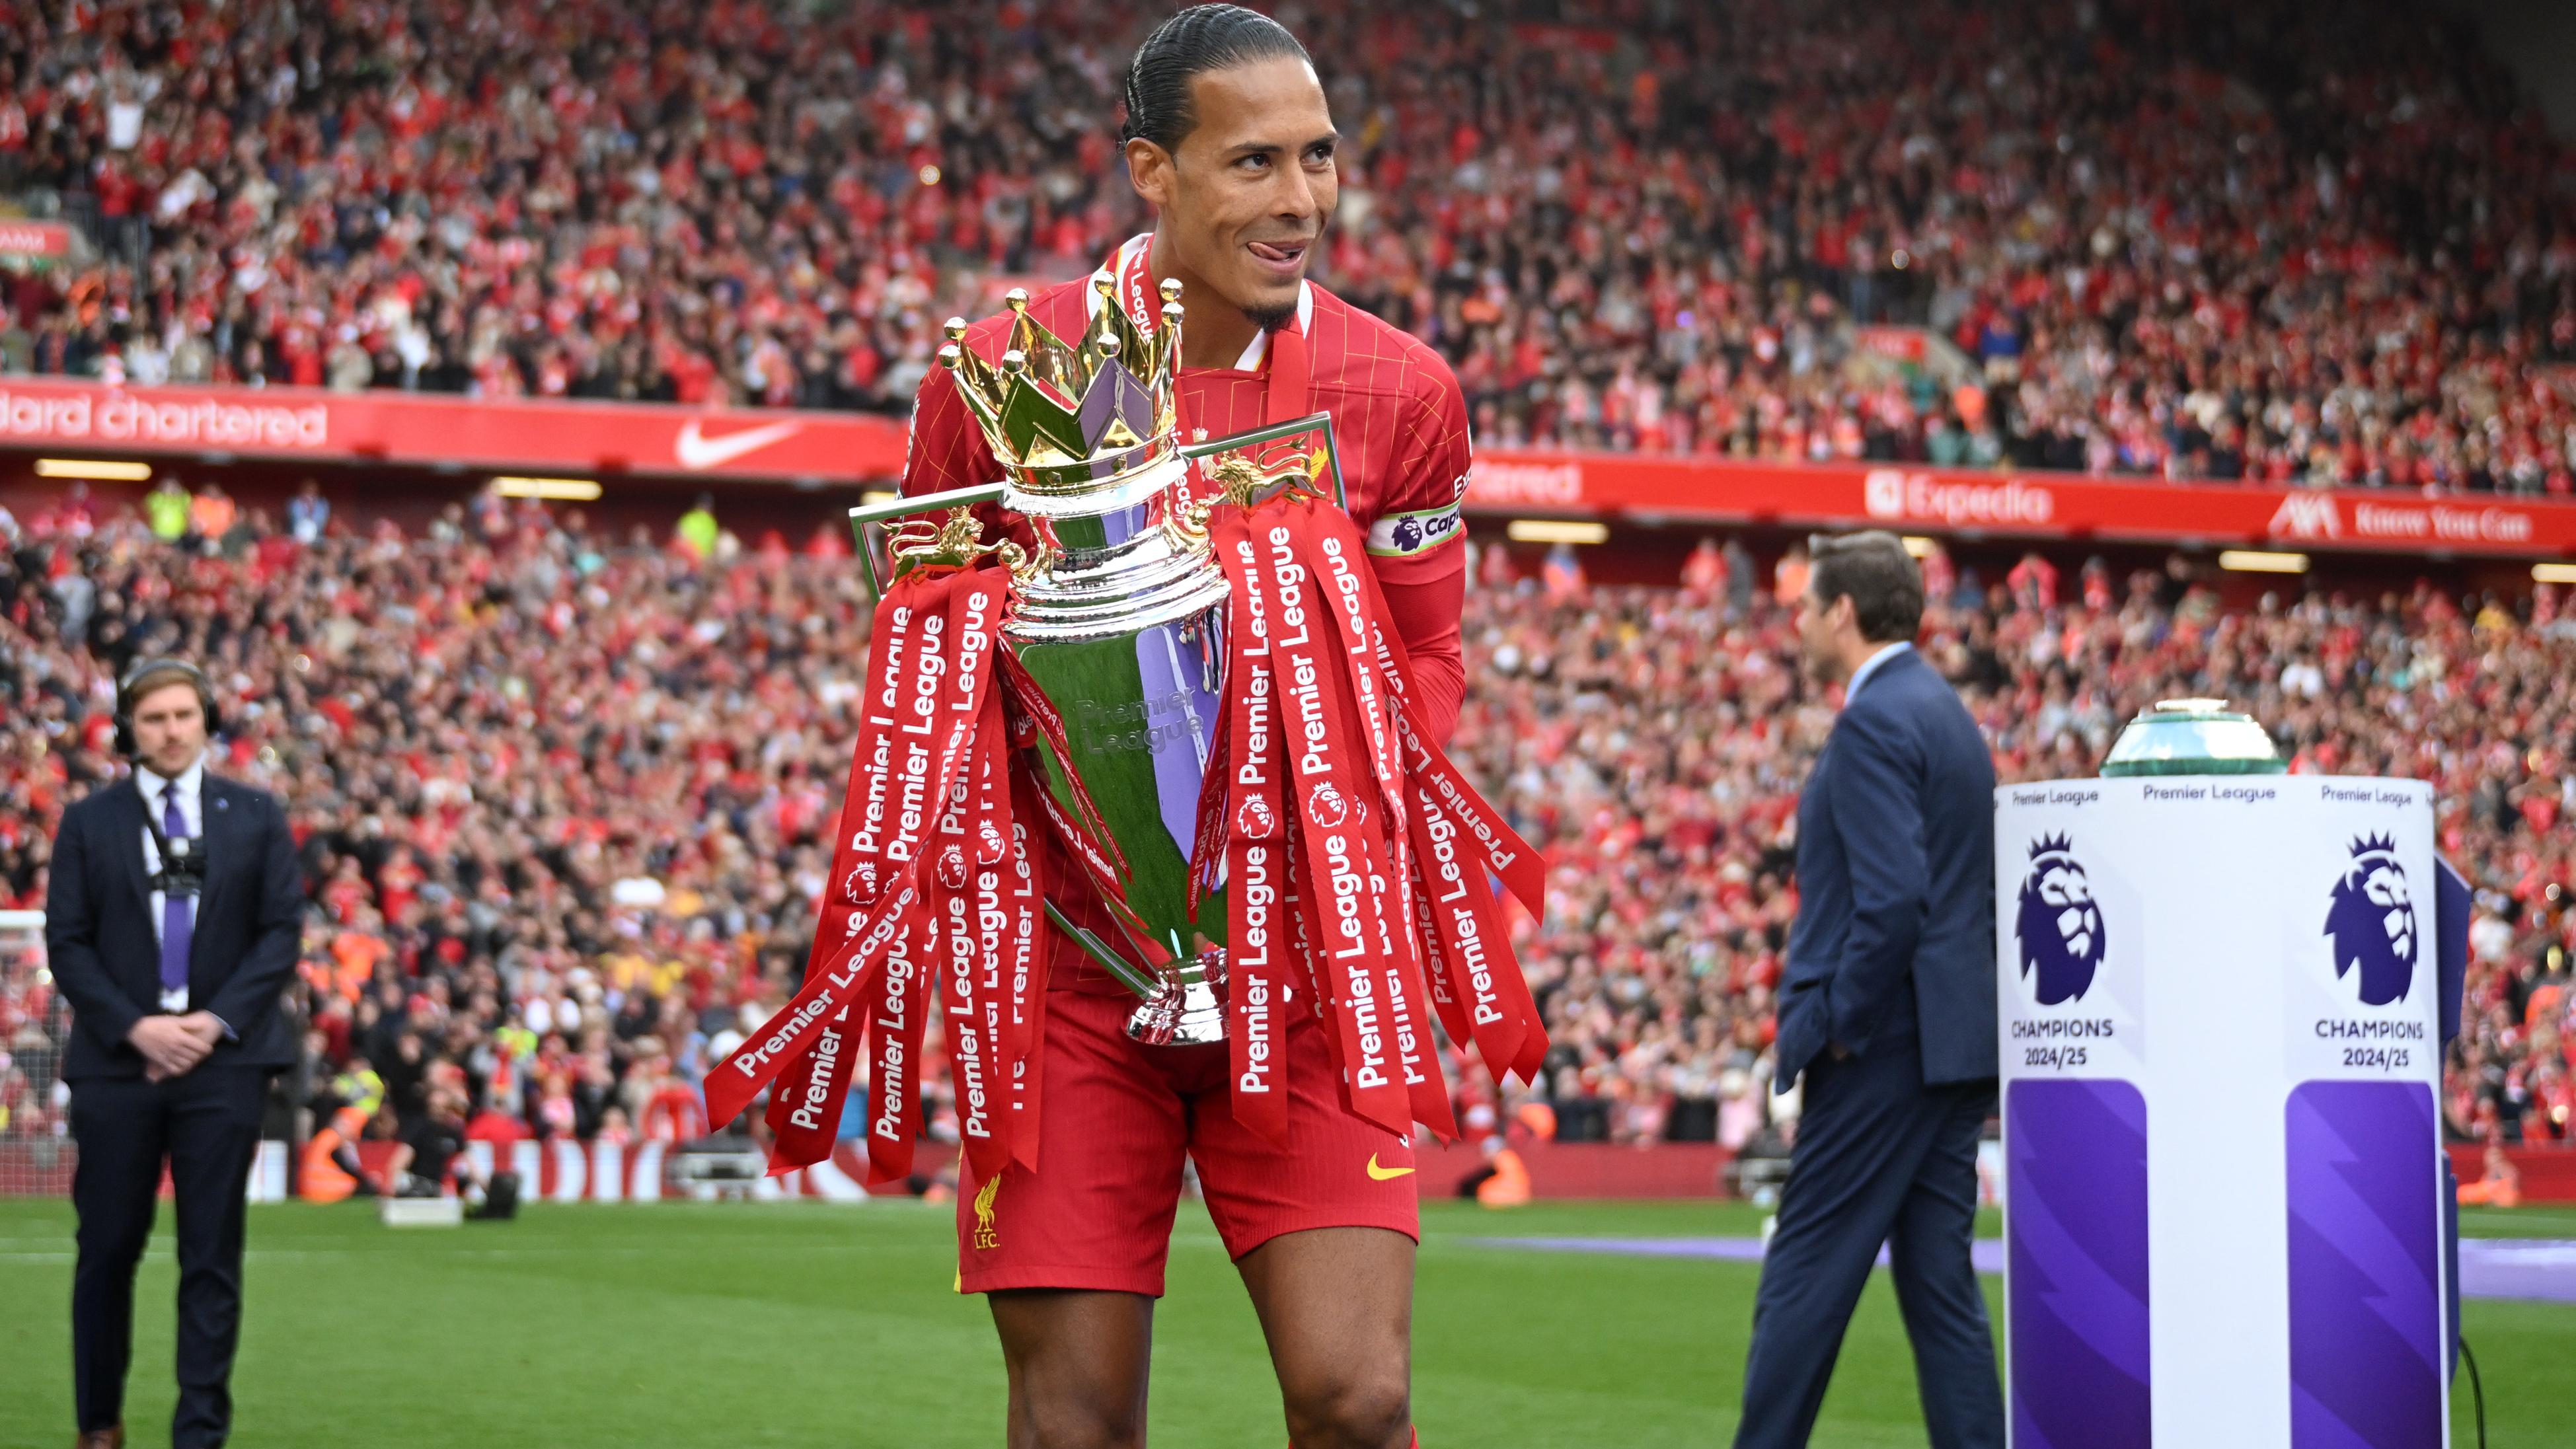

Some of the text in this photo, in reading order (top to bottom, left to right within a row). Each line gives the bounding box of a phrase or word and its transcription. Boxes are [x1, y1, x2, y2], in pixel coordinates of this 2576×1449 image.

[94, 395, 328, 445] chartered
[1907, 473, 2053, 524] Expedia
[2356, 503, 2431, 537] Know
[2431, 505, 2481, 540] You
[952, 592, 989, 711] League
[1269, 527, 1332, 775] Premier League
[1322, 537, 1392, 782] Premier League
[887, 615, 946, 862] Premier League
[1076, 685, 1195, 729] Premier
[1081, 714, 1203, 755] League
[1239, 665, 1269, 784] Premier
[852, 733, 891, 852] Premier
[1430, 772, 1516, 871] Premier
[2012, 791, 2045, 806] Premier
[2050, 788, 2099, 806] League
[2143, 784, 2276, 802] Premier League
[2321, 785, 2372, 802] Premier
[2375, 788, 2412, 807] League
[1010, 823, 1034, 897] Leag
[1326, 835, 1365, 959] League
[734, 887, 914, 1078] Premier League
[978, 872, 1007, 988] League
[1238, 846, 1275, 1092] Premier League
[1419, 891, 1453, 1004] Premier
[1453, 908, 1503, 1025] Premier
[949, 897, 991, 1138] Premier League
[1345, 965, 1388, 1088] Premier
[2011, 1019, 2114, 1038] CHAMPIONS
[2024, 1045, 2087, 1070] 2024/25
[2315, 1020, 2423, 1039] CHAMPIONS
[2343, 1047, 2409, 1072] 2024/25
[790, 1026, 842, 1129] Premier
[876, 1033, 904, 1142] Premier
